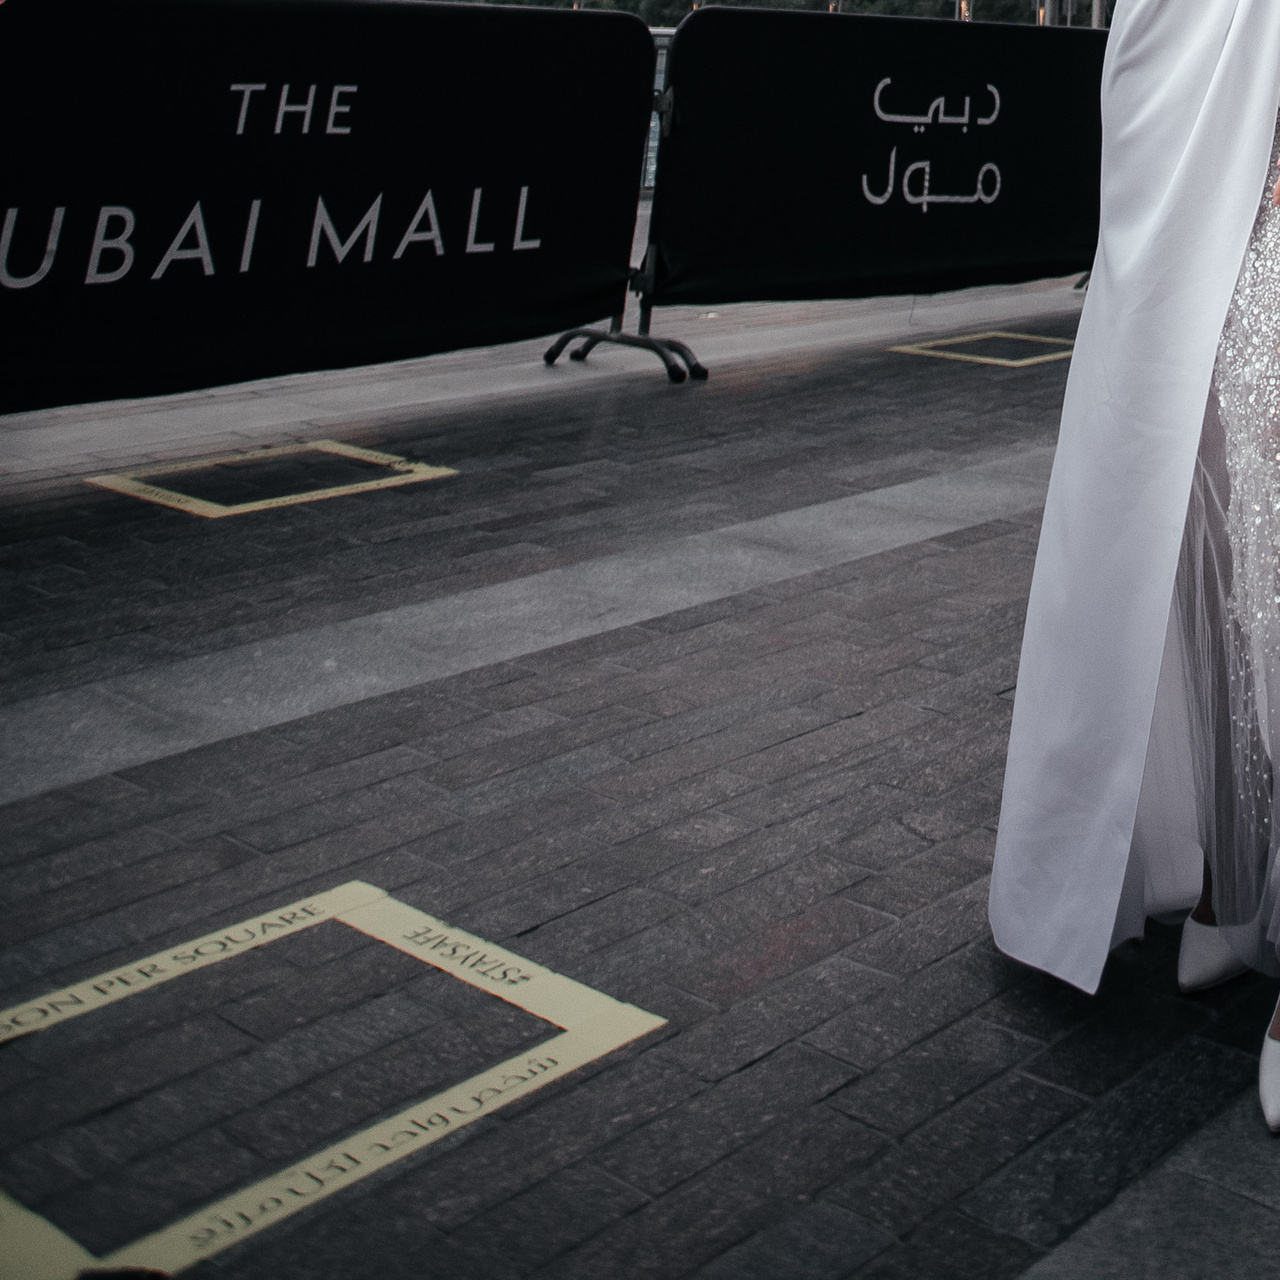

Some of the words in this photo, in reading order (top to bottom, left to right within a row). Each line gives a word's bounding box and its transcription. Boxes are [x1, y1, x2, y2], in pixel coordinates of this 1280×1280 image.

[229, 83, 359, 136] THE
[872, 77, 1001, 134] دبي
[861, 145, 1003, 214] مول
[306, 185, 542, 269] MALL
[93, 962, 167, 995] PER
[173, 903, 326, 965] SQUARE
[402, 926, 534, 985] #STAYSAFE
